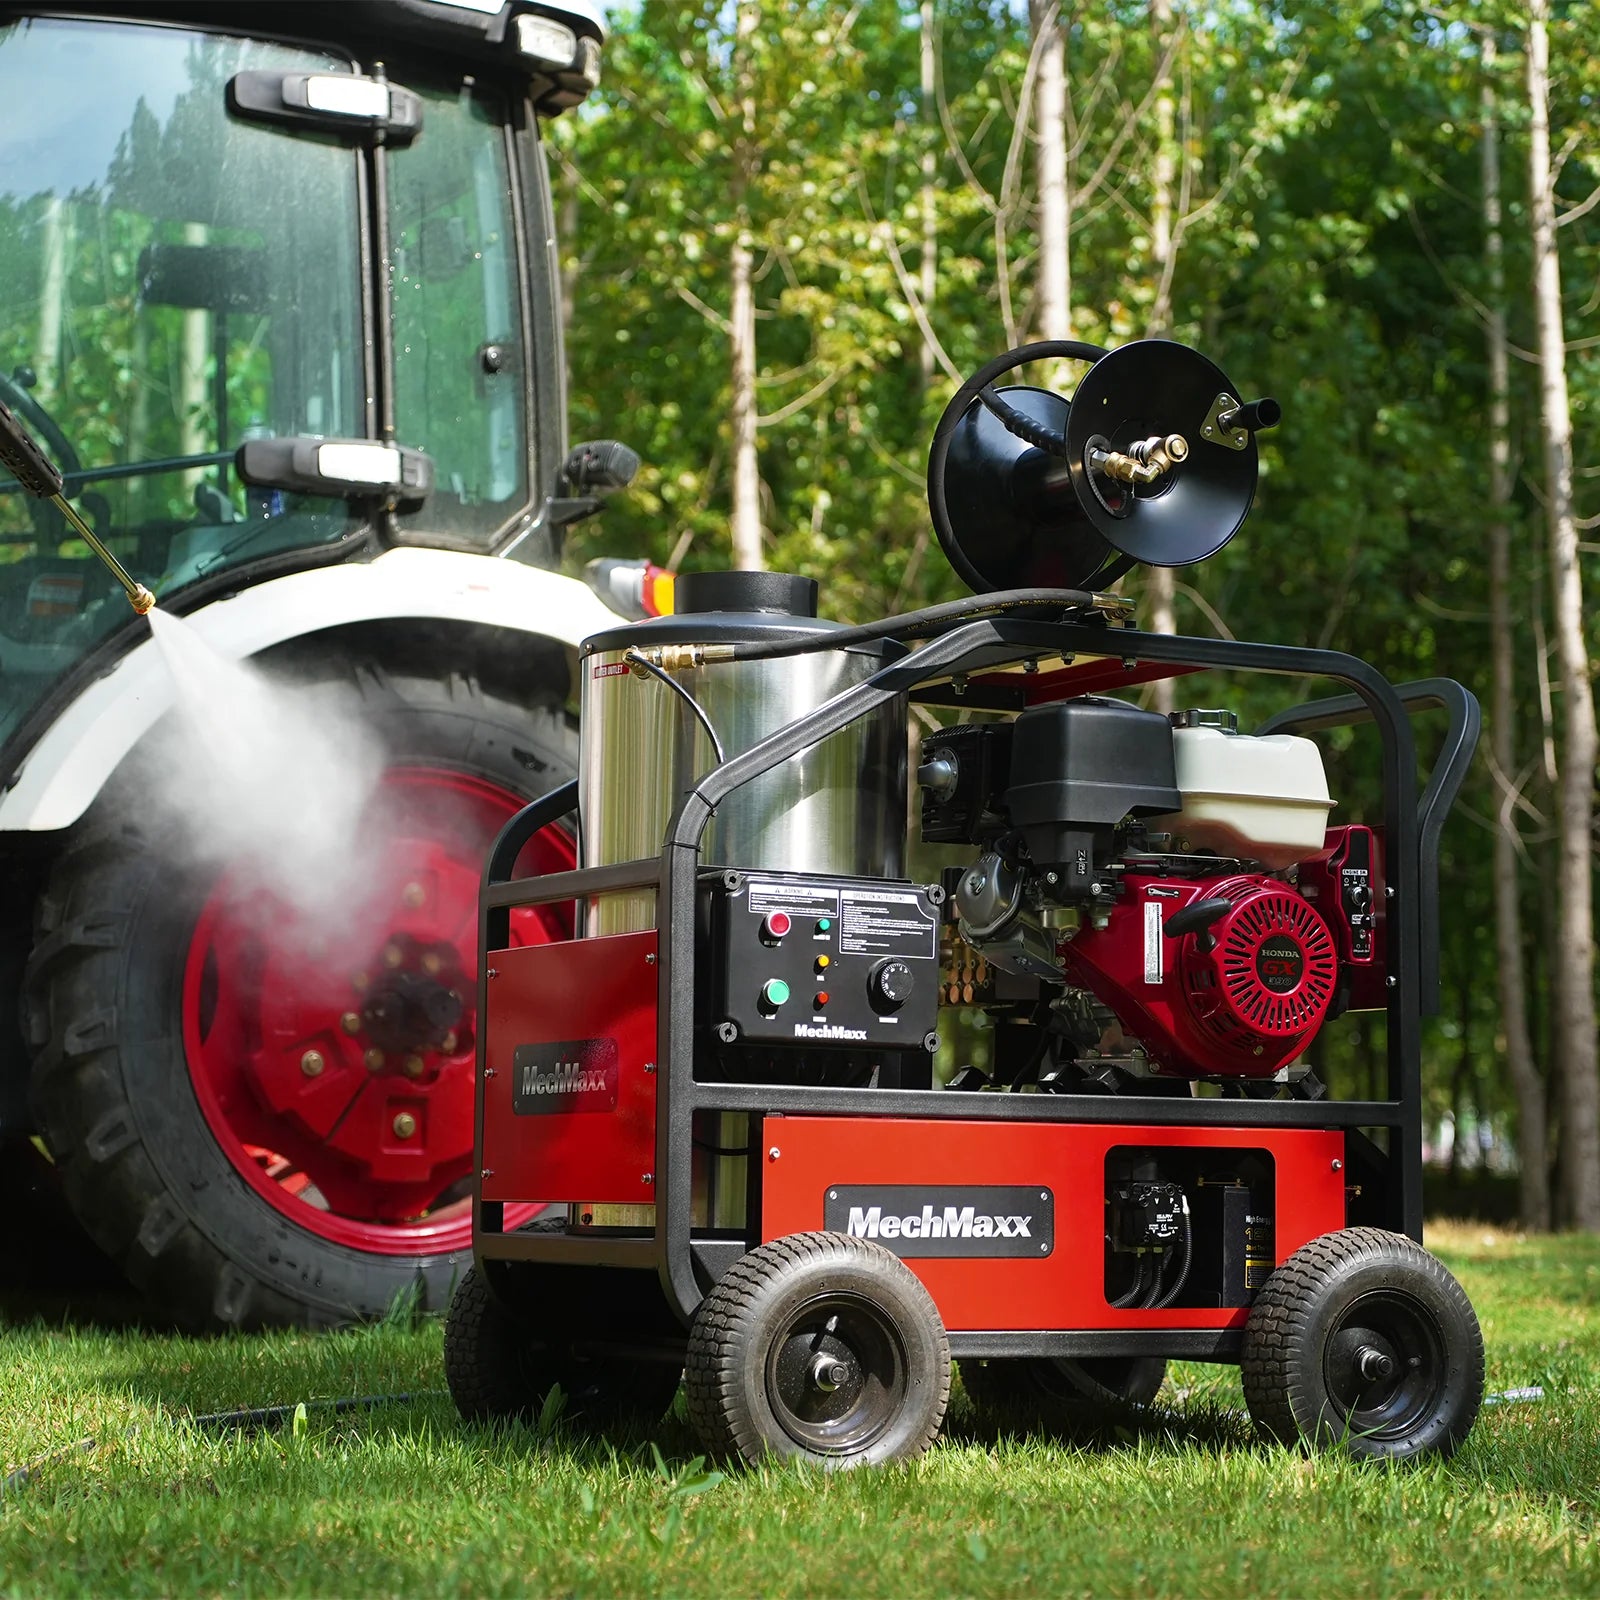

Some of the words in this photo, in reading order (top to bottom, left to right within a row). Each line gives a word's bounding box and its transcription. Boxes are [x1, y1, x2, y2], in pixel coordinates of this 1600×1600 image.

[1262, 949, 1299, 958] HONDA
[1262, 960, 1297, 976] GX
[794, 1024, 867, 1040] MechMaxx
[522, 1062, 607, 1095] MechMaxx
[847, 1205, 1032, 1238] MechMaxx
